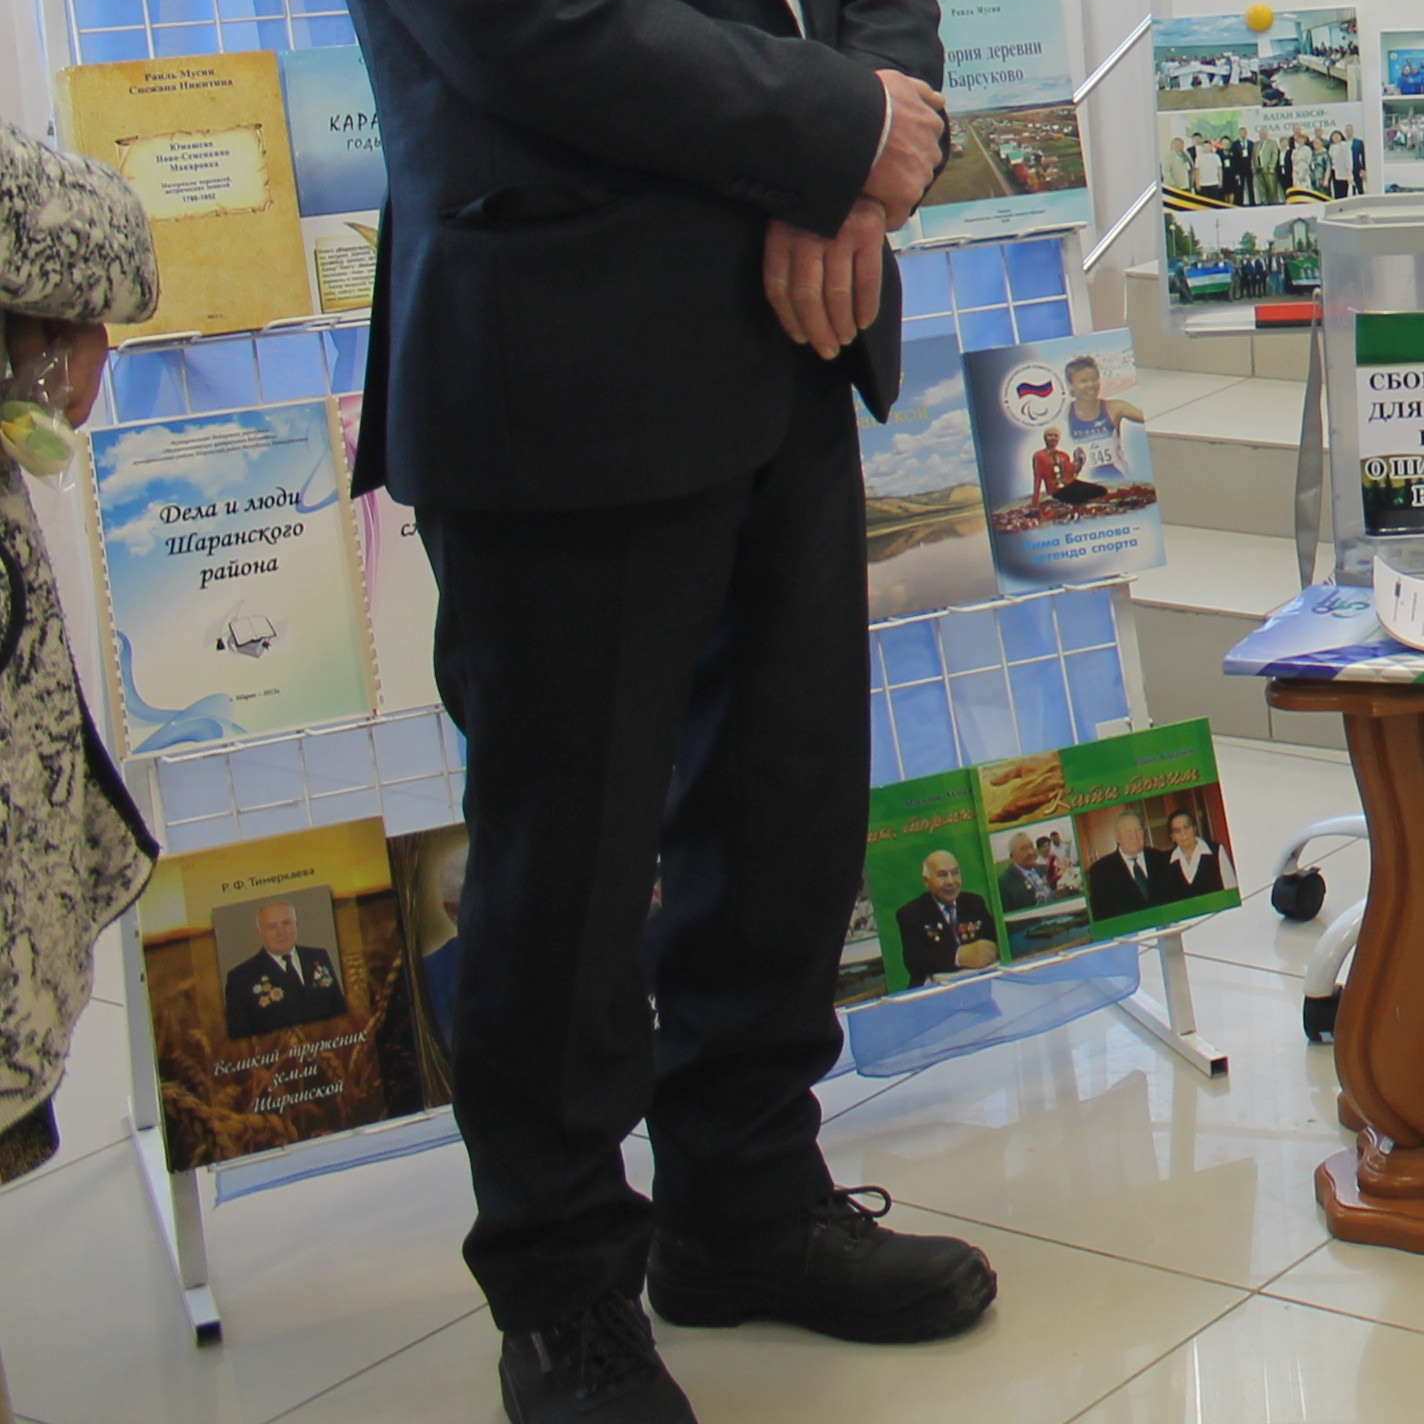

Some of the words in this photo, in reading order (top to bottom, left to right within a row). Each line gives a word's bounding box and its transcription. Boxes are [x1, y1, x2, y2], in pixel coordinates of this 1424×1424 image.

[987, 41, 1043, 63] деревни
[947, 68, 1024, 91] Барсуково
[1368, 400, 1423, 423] ДЛЯ
[1366, 458, 1386, 478] О
[159, 501, 218, 524] Дела
[225, 499, 239, 514] и
[244, 486, 302, 513] люди
[165, 522, 304, 557] Шаранского
[1064, 526, 1131, 544] Баталова
[1091, 537, 1138, 553] спорта
[199, 557, 279, 590] района
[249, 867, 315, 888] Тимеркаева
[212, 1048, 281, 1076] Великий
[288, 1030, 368, 1063] труженик
[267, 1064, 318, 1093] земли
[251, 1078, 344, 1114] Шаранской
